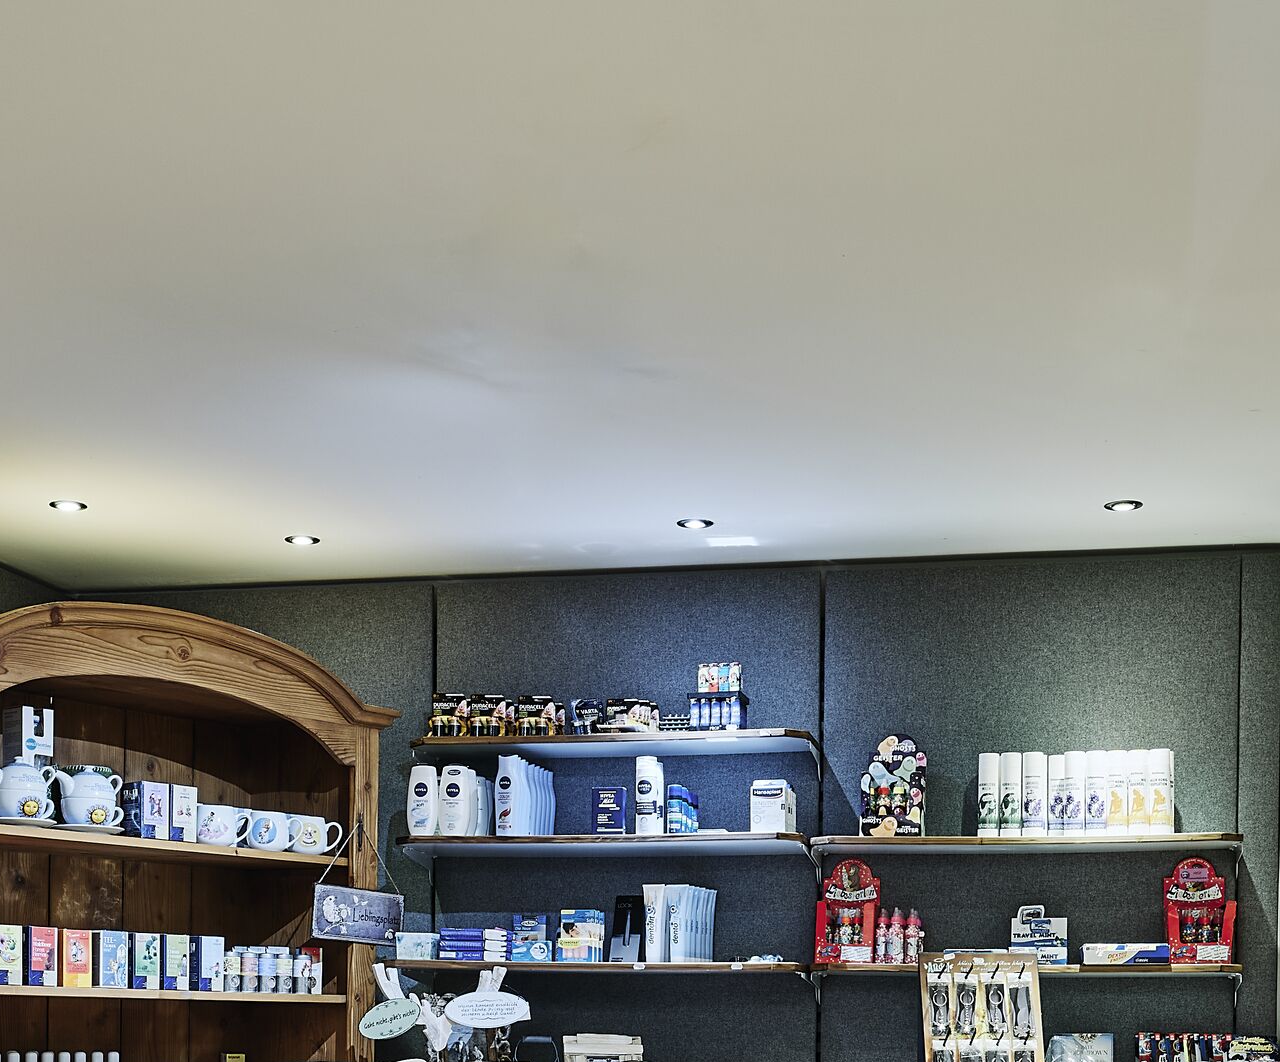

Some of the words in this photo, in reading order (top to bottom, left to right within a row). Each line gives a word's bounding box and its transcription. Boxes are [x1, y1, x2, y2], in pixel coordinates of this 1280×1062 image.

[471, 702, 497, 710] DURACELL
[580, 707, 599, 715] VARTA
[890, 743, 917, 752] GHOSTS
[873, 754, 903, 763] GEISTER
